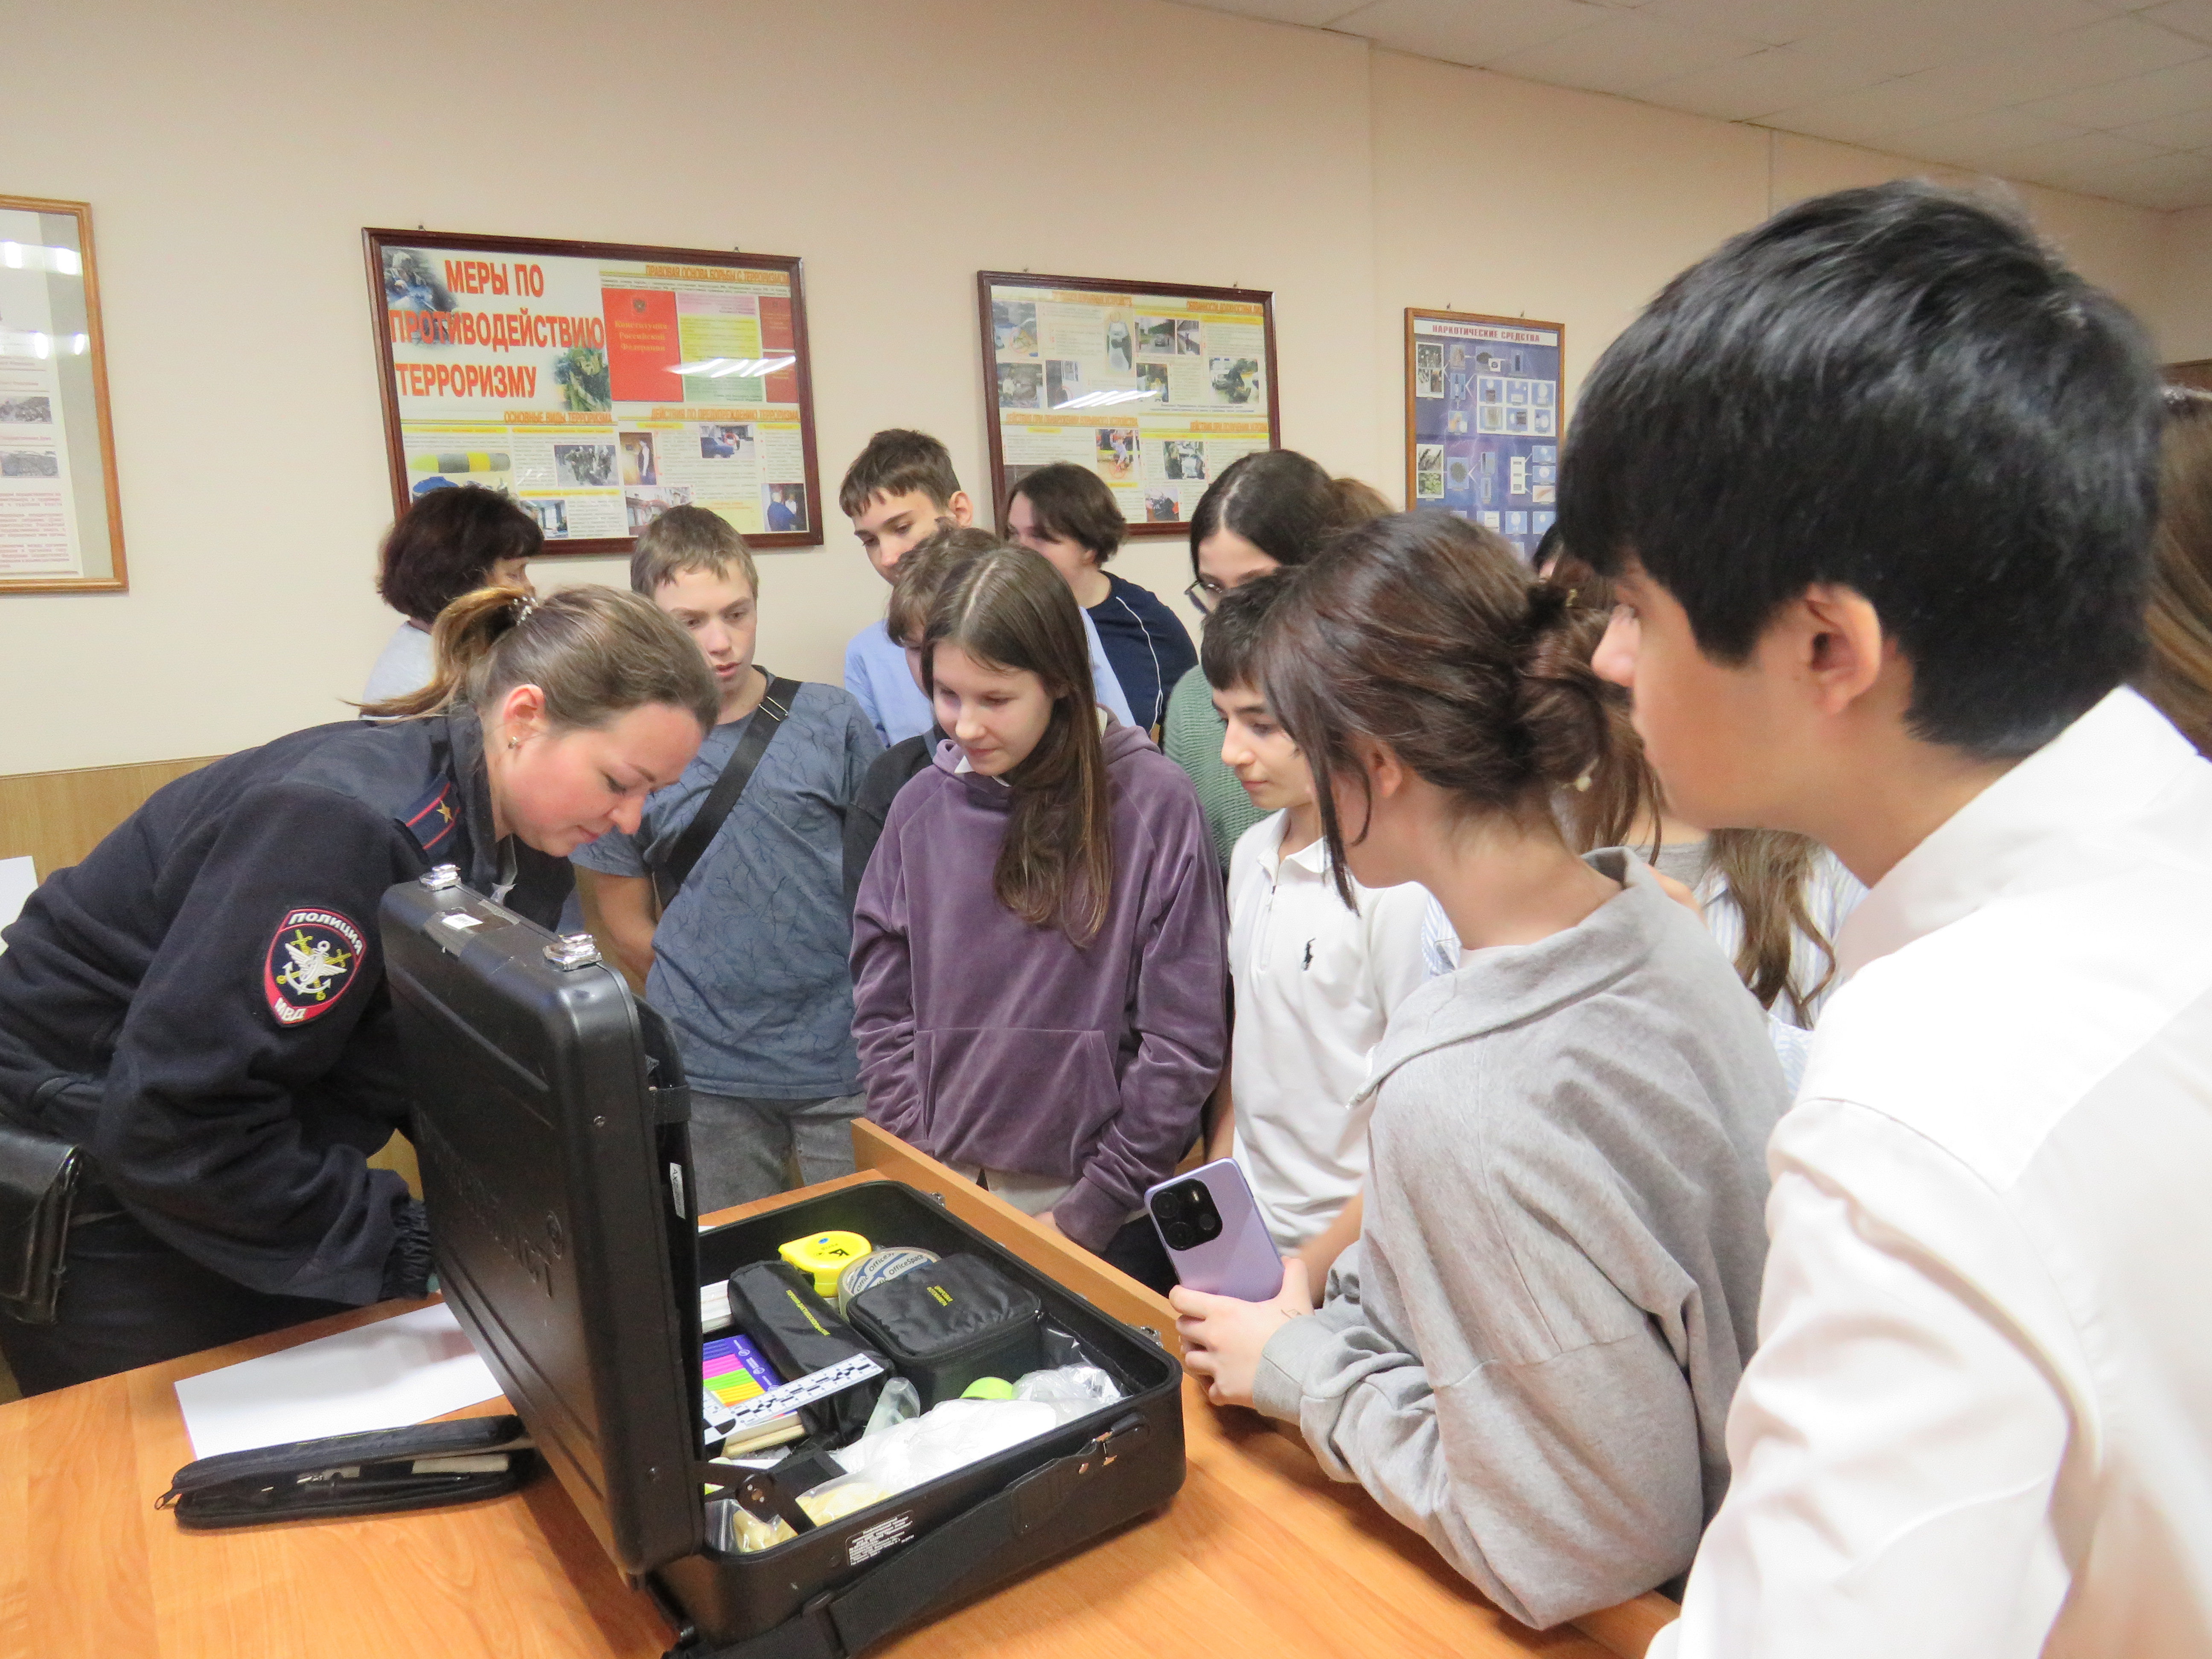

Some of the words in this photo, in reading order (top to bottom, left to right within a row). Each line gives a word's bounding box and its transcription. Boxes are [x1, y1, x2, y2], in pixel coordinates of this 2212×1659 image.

[445, 259, 509, 296] МЕРЫ
[514, 264, 544, 297] ПО
[388, 308, 605, 352] ПРОТИВОДЕЙСТВИЮ
[1432, 325, 1498, 338] НАРКОТИЧЕСКИЕ
[1501, 332, 1540, 342] СРЕДСТВА
[395, 363, 537, 398] ТЕРРОРИЗМУ
[504, 411, 544, 423] ОСНОВНЫЕ
[288, 912, 363, 956] ПОЛИЦИЯ
[274, 997, 307, 1022] МВД
